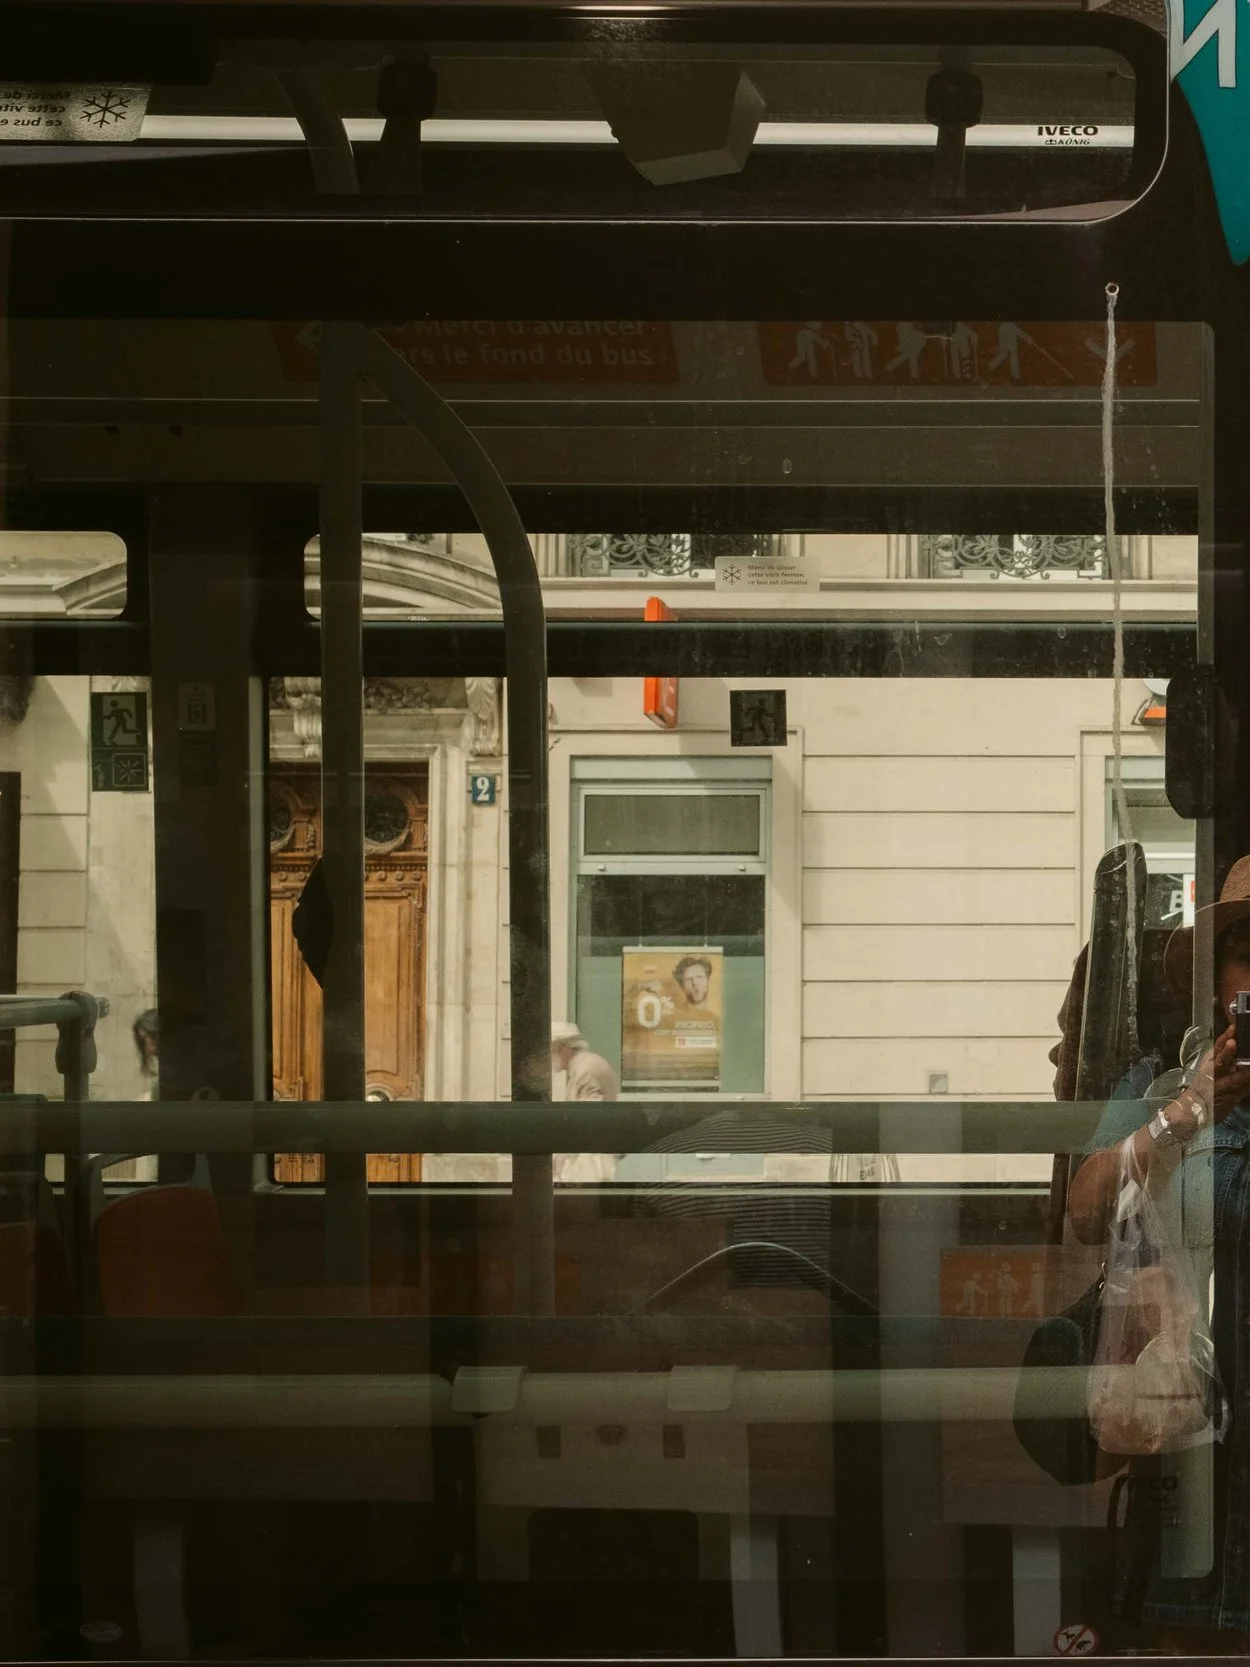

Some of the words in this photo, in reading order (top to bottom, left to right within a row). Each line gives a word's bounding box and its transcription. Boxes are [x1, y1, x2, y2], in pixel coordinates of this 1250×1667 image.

[1038, 125, 1099, 136] IVECO
[1057, 138, 1091, 146] KÖNIG
[442, 343, 471, 365] le
[479, 343, 547, 366] fond
[556, 343, 593, 366] du
[601, 343, 654, 367] bus
[476, 776, 490, 801] 2
